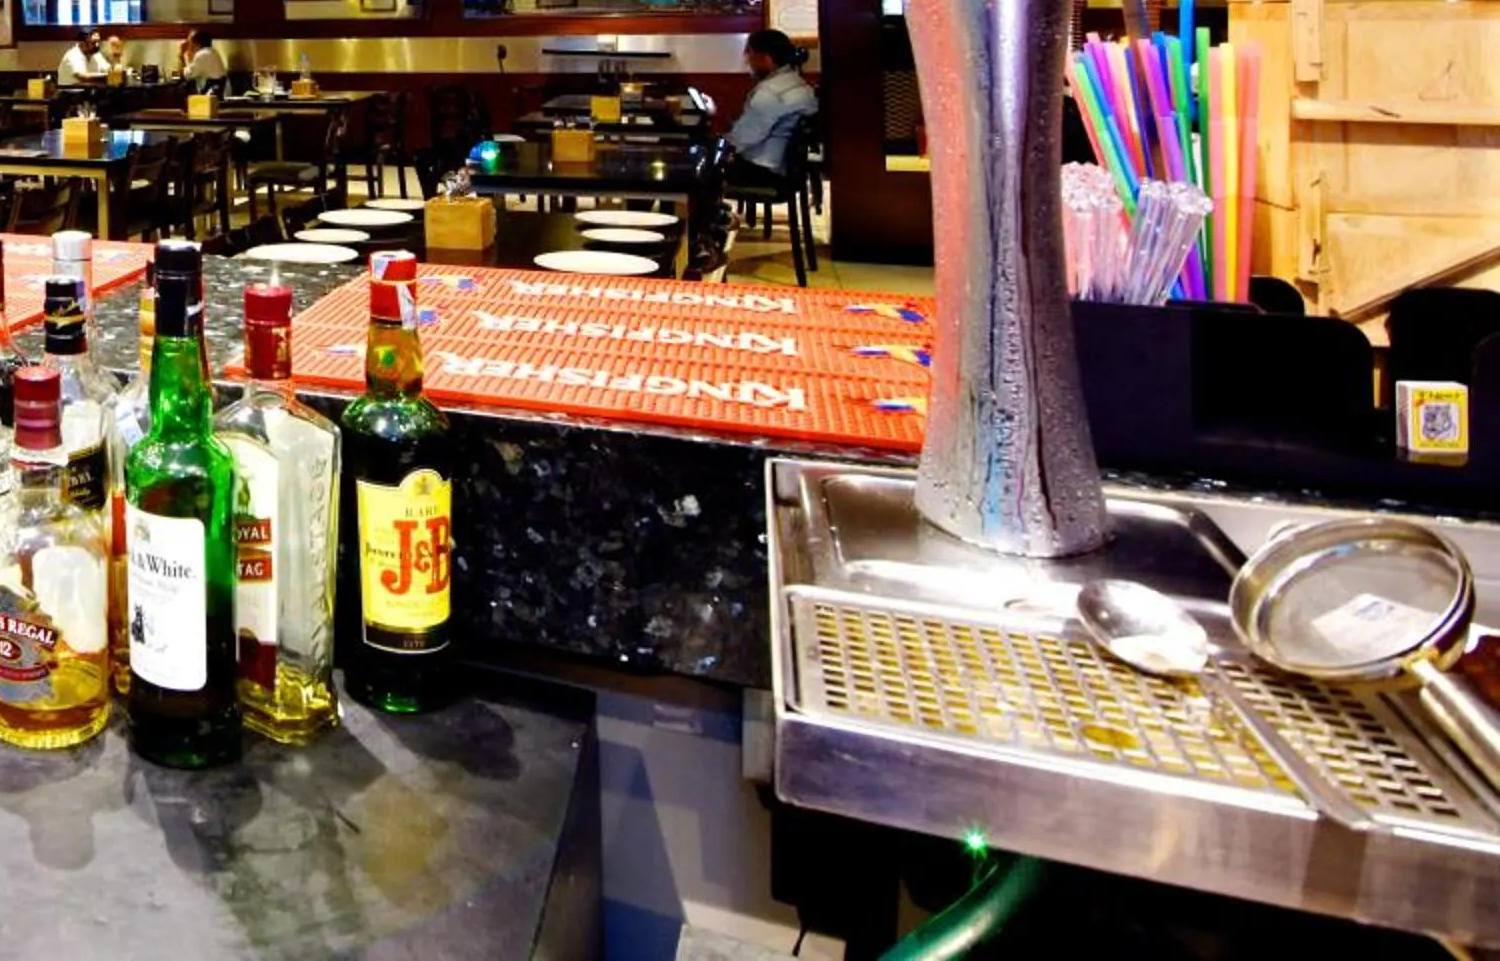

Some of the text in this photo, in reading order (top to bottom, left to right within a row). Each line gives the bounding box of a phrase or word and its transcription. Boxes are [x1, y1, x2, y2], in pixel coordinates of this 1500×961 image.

[512, 281, 798, 314] KINGFISHER
[476, 311, 799, 355] KINGFISHER
[440, 353, 808, 411] KINGFISHER
[236, 562, 265, 576] TAG
[7, 618, 55, 645] REGAL
[0, 640, 13, 658] 12
